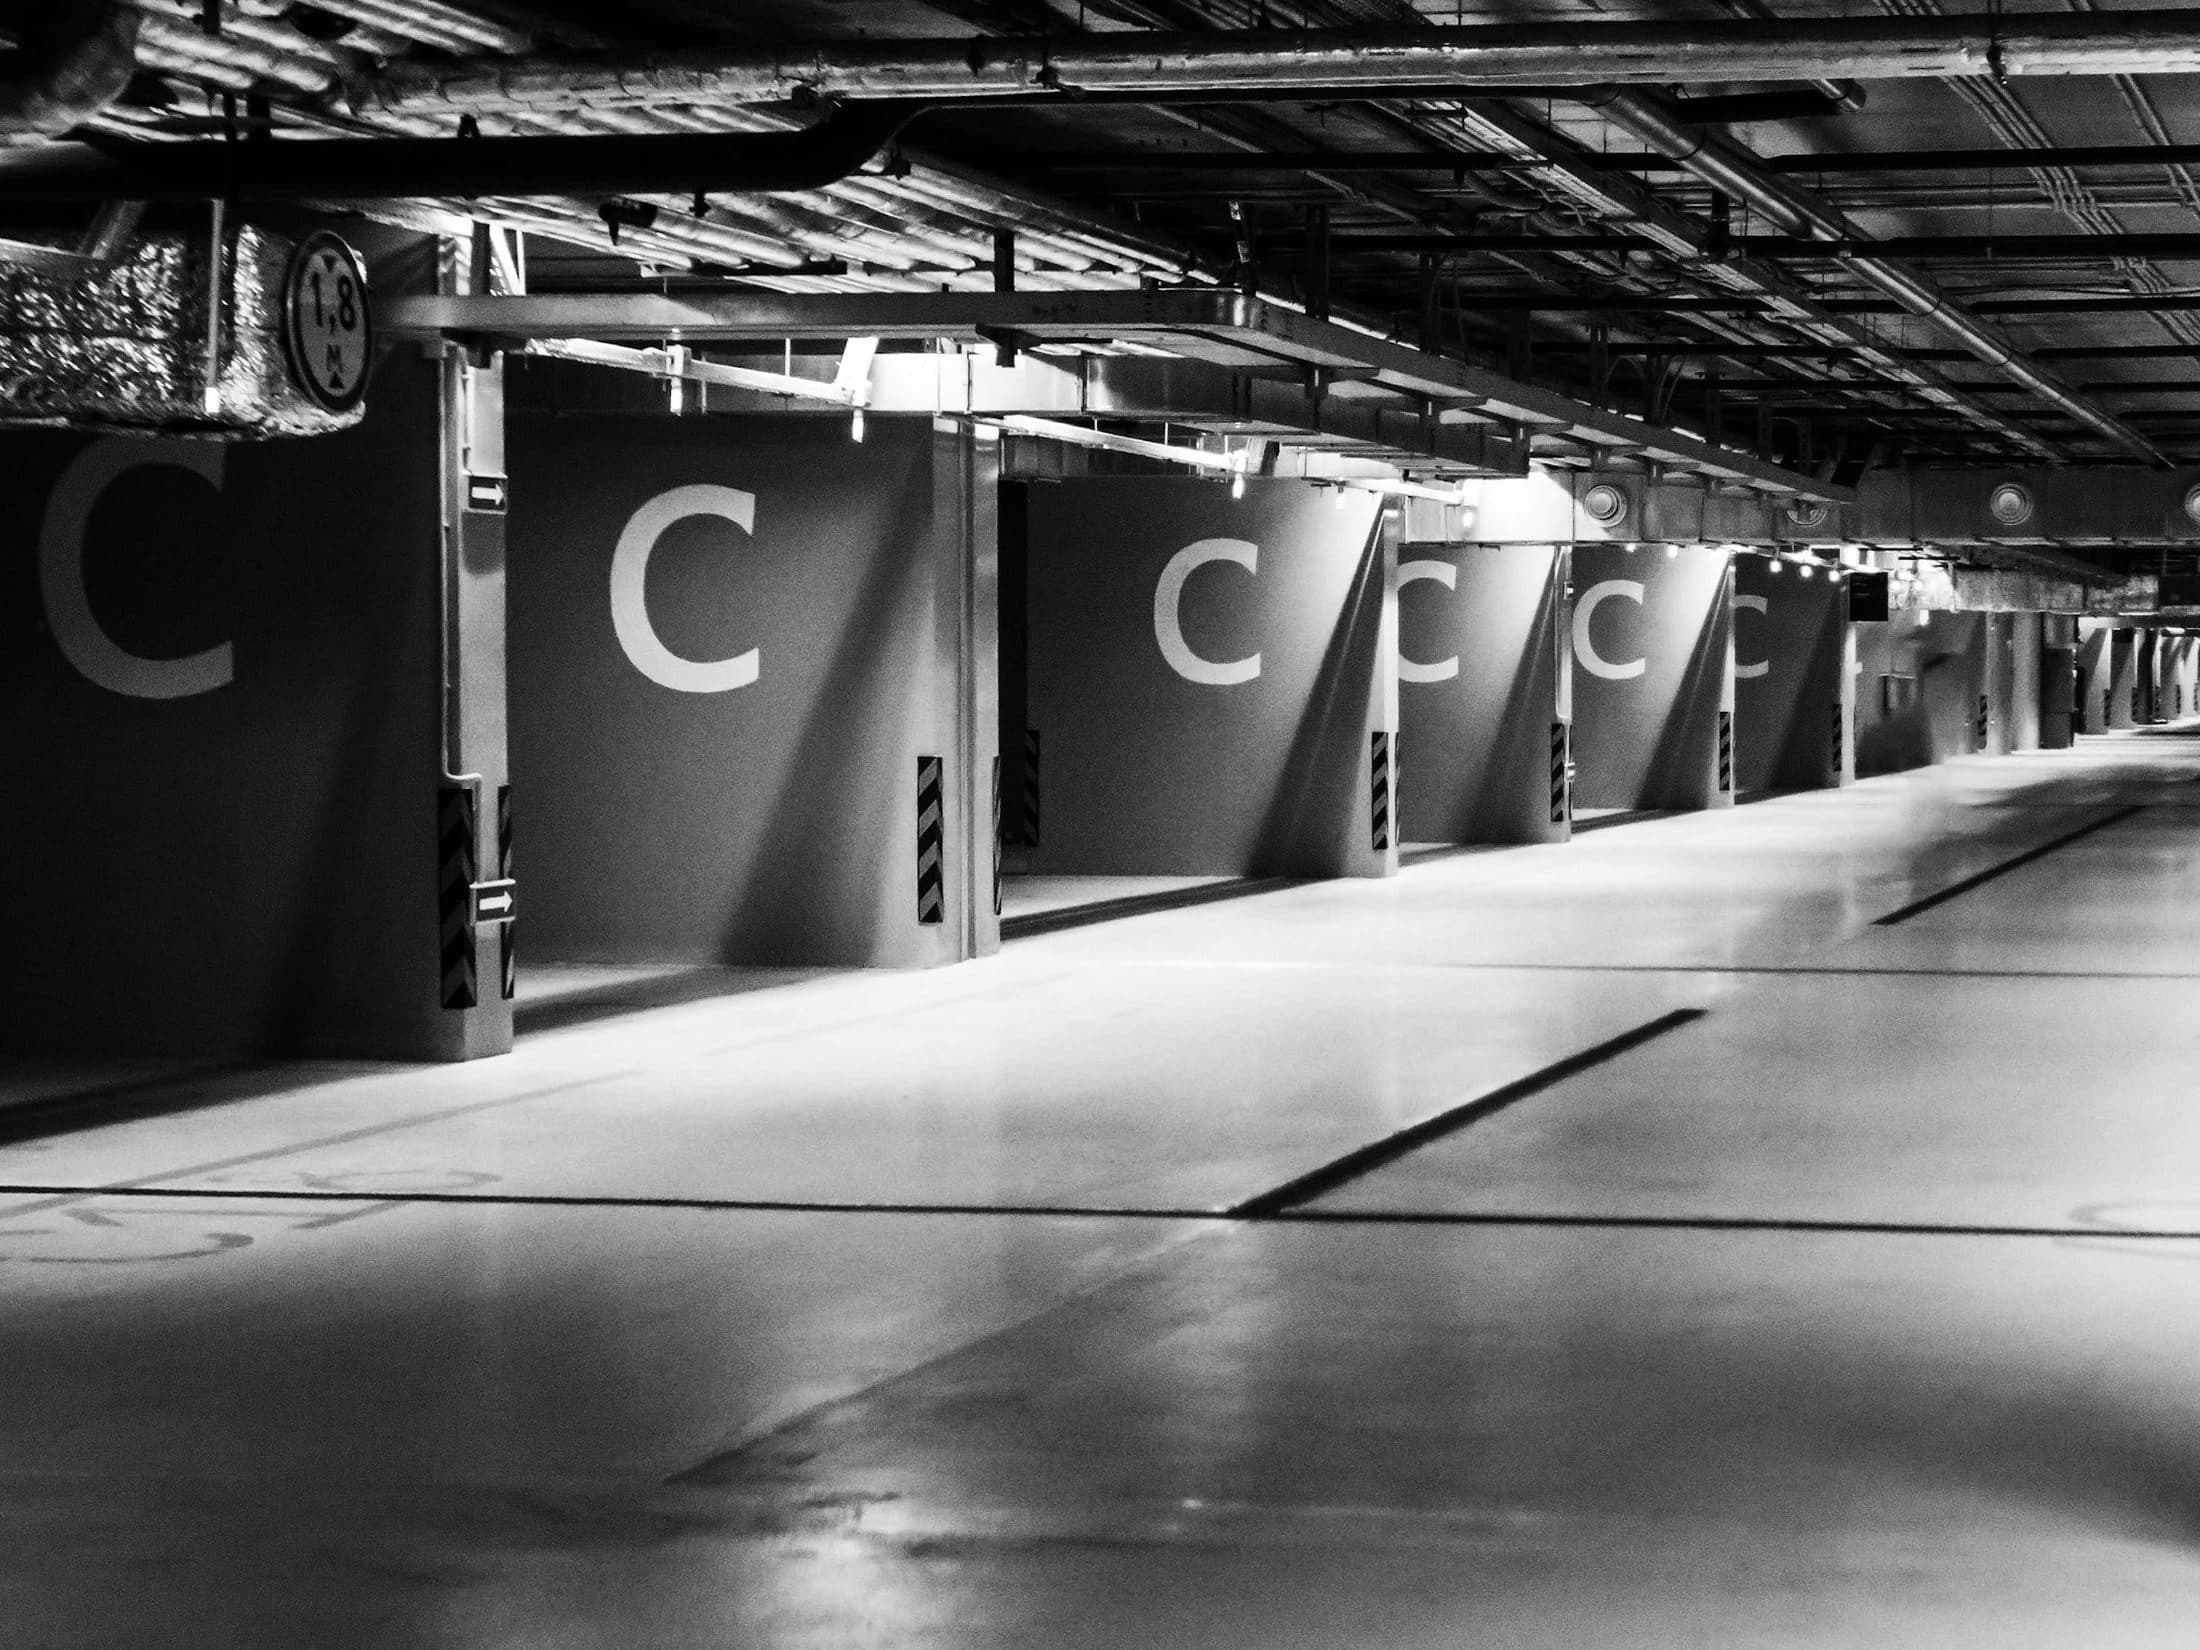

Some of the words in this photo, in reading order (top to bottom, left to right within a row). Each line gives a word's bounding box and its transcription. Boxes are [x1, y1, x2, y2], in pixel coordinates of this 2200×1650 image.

[311, 271, 357, 337] 1,8
[38, 433, 234, 700] C
[609, 483, 760, 693] C
[1153, 537, 1261, 686] C
[1397, 559, 1459, 684] C
[1572, 579, 1646, 680] C
